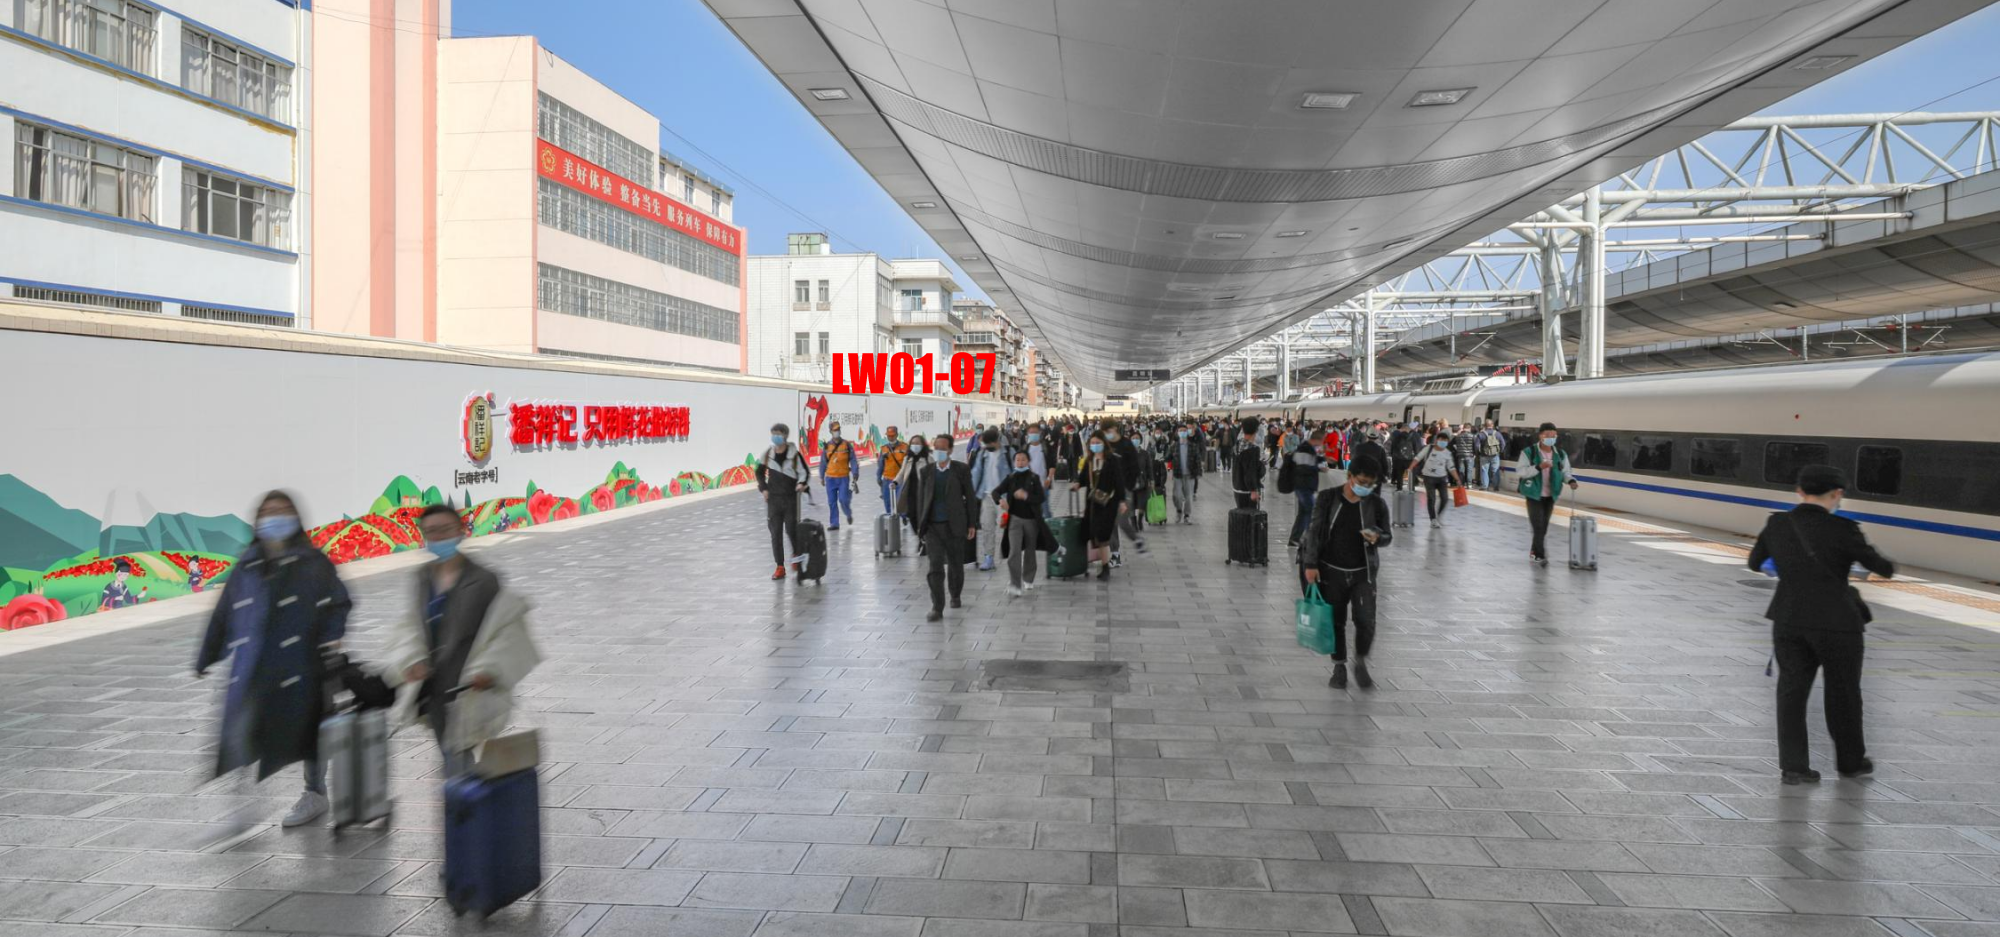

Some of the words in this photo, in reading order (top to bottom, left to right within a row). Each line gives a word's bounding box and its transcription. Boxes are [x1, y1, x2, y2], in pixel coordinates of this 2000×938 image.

[563, 157, 612, 196] 美好体验
[620, 183, 662, 217] 整备当先
[667, 204, 701, 233] 服务列车
[509, 402, 578, 444] 潘祥记
